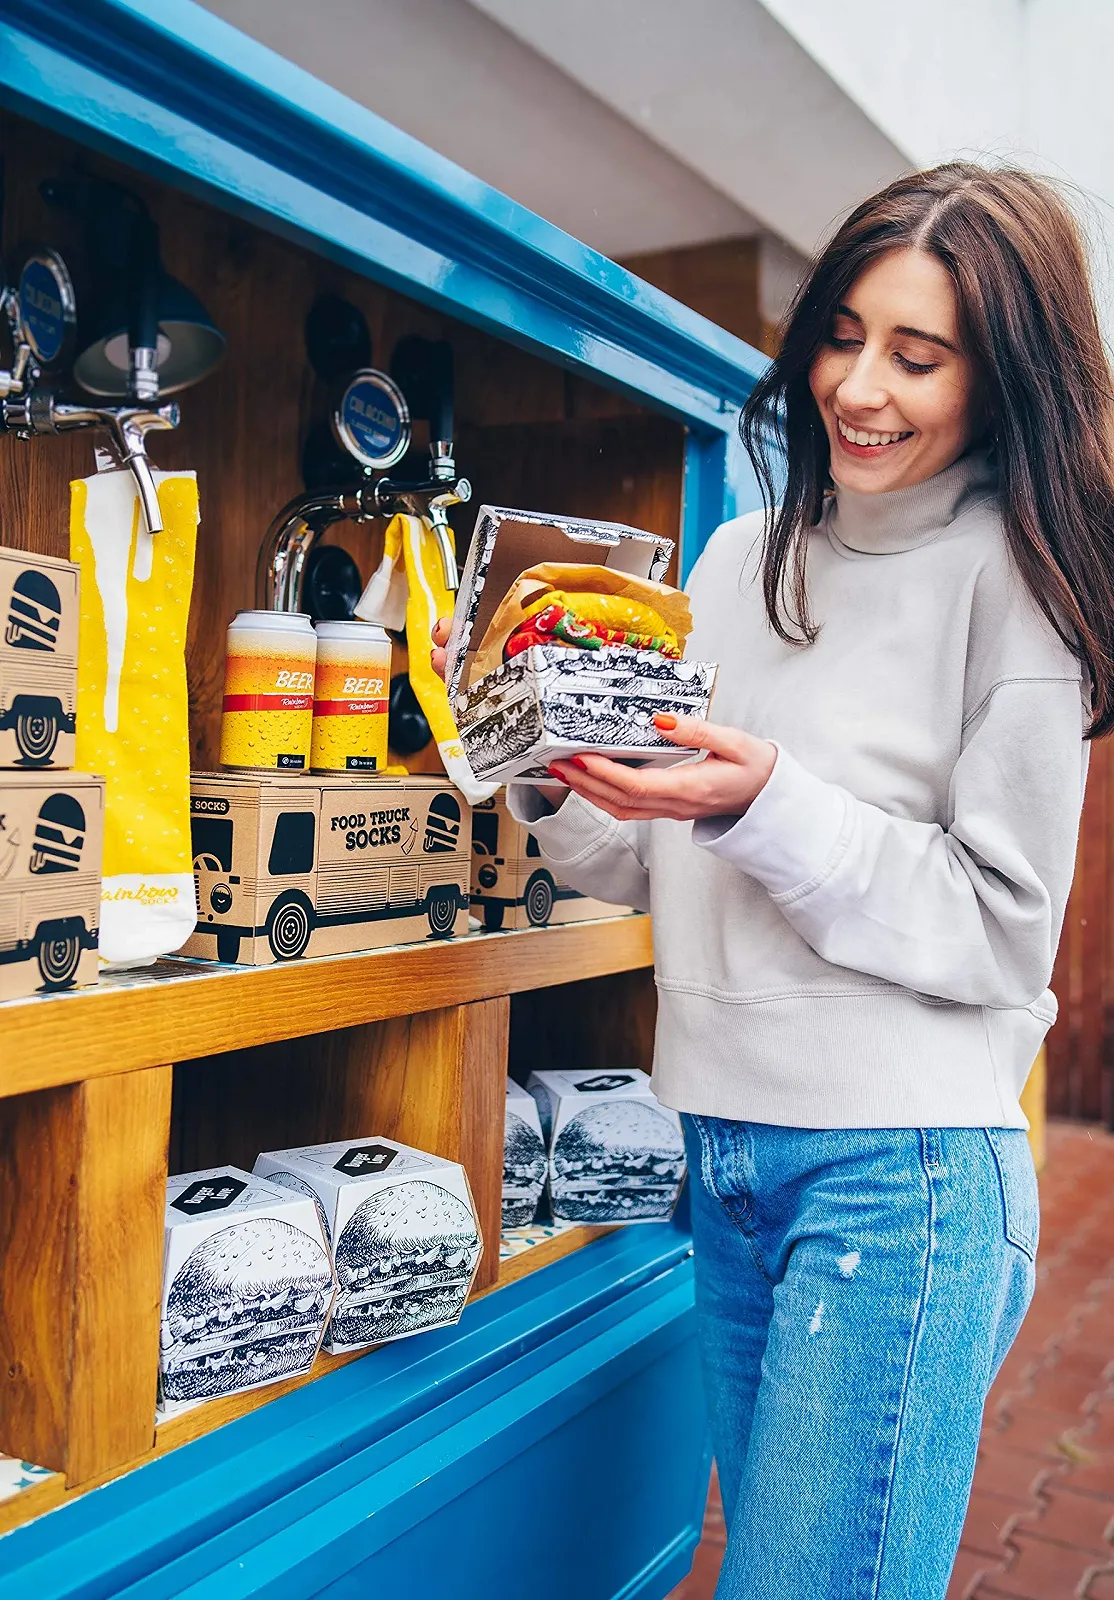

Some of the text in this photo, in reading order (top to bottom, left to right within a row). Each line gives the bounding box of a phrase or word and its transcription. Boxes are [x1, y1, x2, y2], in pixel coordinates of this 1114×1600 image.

[275, 670, 313, 689] BEER
[342, 677, 384, 695] BEER
[348, 702, 375, 711] Rainbow
[194, 800, 227, 812] SOCKS
[330, 807, 410, 832] FOOD TRUCK
[345, 824, 401, 851] SOCKS
[100, 883, 179, 901] ainbow
